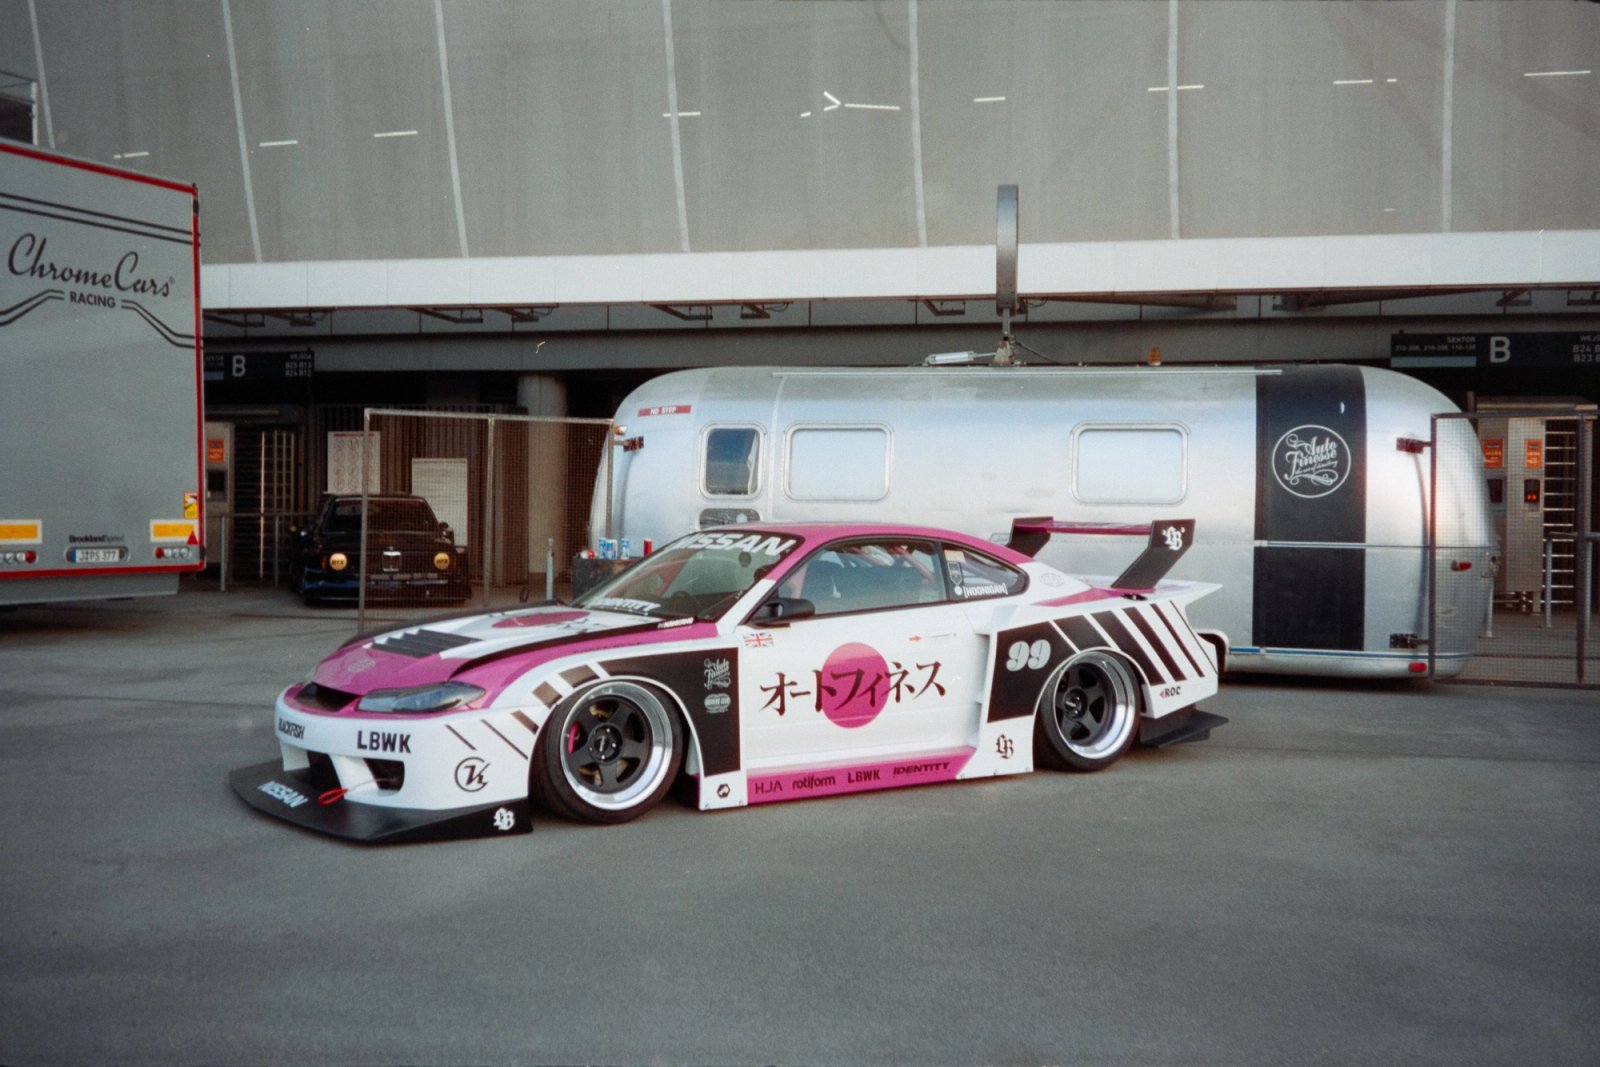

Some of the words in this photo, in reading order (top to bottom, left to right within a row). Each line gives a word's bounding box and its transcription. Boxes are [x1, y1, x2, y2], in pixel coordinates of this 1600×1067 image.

[8, 232, 170, 297] ChromeCars
[69, 291, 117, 308] RACING
[1489, 336, 1511, 364] B
[231, 355, 246, 378] B
[1006, 639, 1051, 671] 99
[759, 660, 946, 716] オートフィネス
[357, 730, 412, 753] LBWK
[792, 775, 836, 790] rotiform
[848, 769, 881, 783] LBWK
[893, 762, 949, 776] IDENTITY
